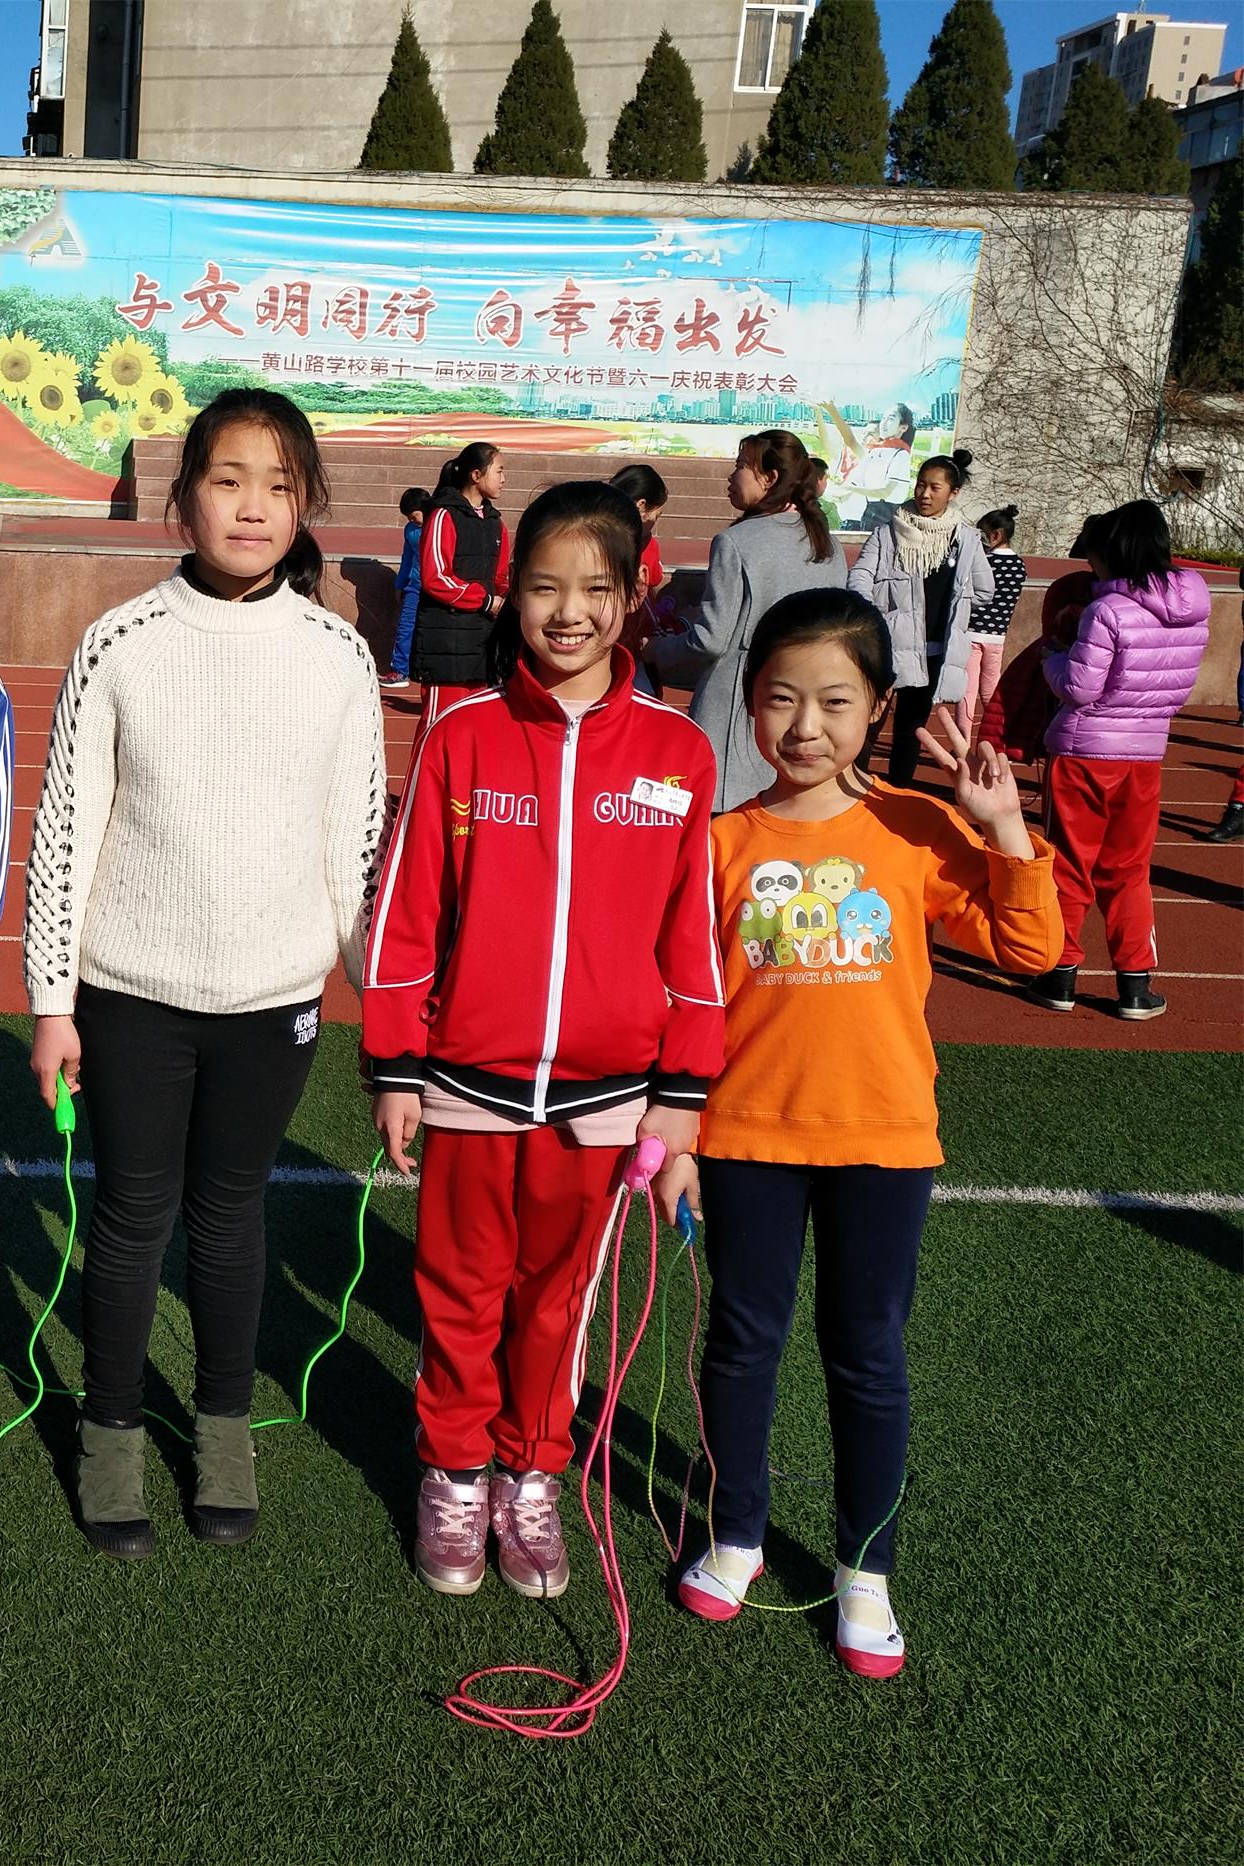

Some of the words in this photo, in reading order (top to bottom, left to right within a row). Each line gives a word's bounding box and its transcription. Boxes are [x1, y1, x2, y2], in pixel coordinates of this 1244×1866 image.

[117, 262, 438, 342] 与文明同行
[475, 277, 787, 357] 向幸福出发
[755, 973, 784, 986] BABY
[785, 971, 820, 985] DUCK
[822, 971, 832, 984] &
[835, 969, 882, 984] friends
